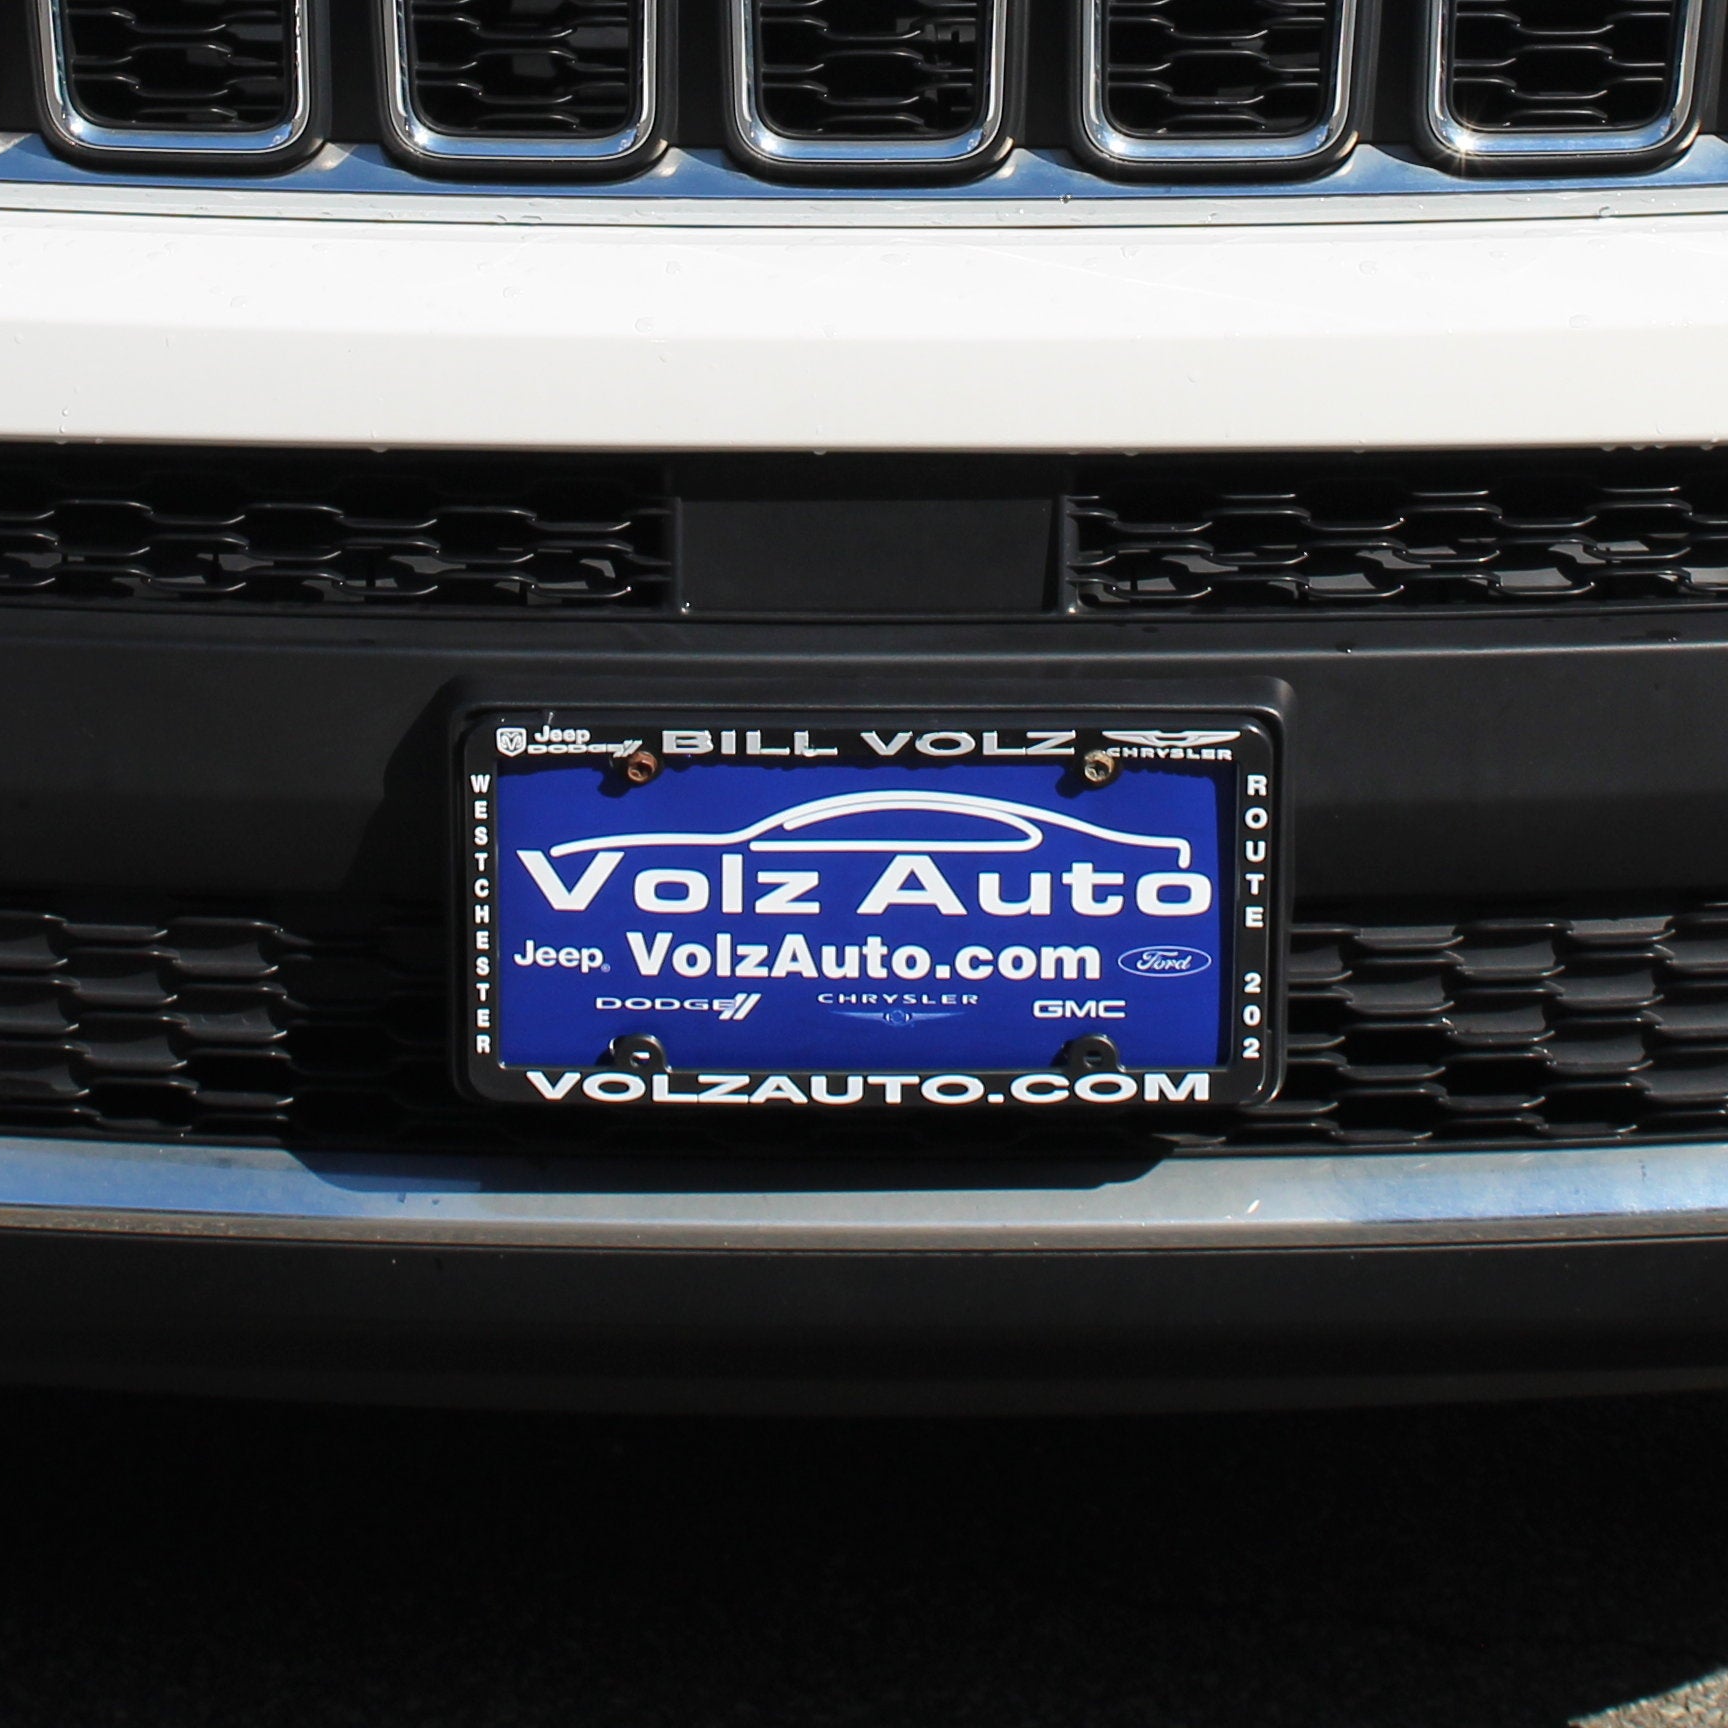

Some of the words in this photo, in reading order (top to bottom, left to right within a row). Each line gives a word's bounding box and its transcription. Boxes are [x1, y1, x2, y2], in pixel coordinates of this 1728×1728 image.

[534, 725, 591, 745] Jeep
[661, 729, 839, 756] BILL
[860, 729, 1077, 757] VOLZ
[1106, 747, 1233, 761] CHRYSLER
[1244, 774, 1270, 929] ROUTE
[515, 849, 821, 914] Volz
[855, 853, 1214, 917] Auto
[469, 773, 491, 1055] WESTCHESTER
[513, 939, 604, 974] Jeep
[625, 931, 1102, 980] VolzAuto.com
[1135, 950, 1193, 972] Ford
[595, 996, 737, 1012] DODGE
[817, 992, 979, 1006] CHRYSLER
[1032, 999, 1127, 1019] GMC
[1242, 972, 1263, 1060] 202
[525, 1071, 1211, 1105] VOLZAUTO.COM
